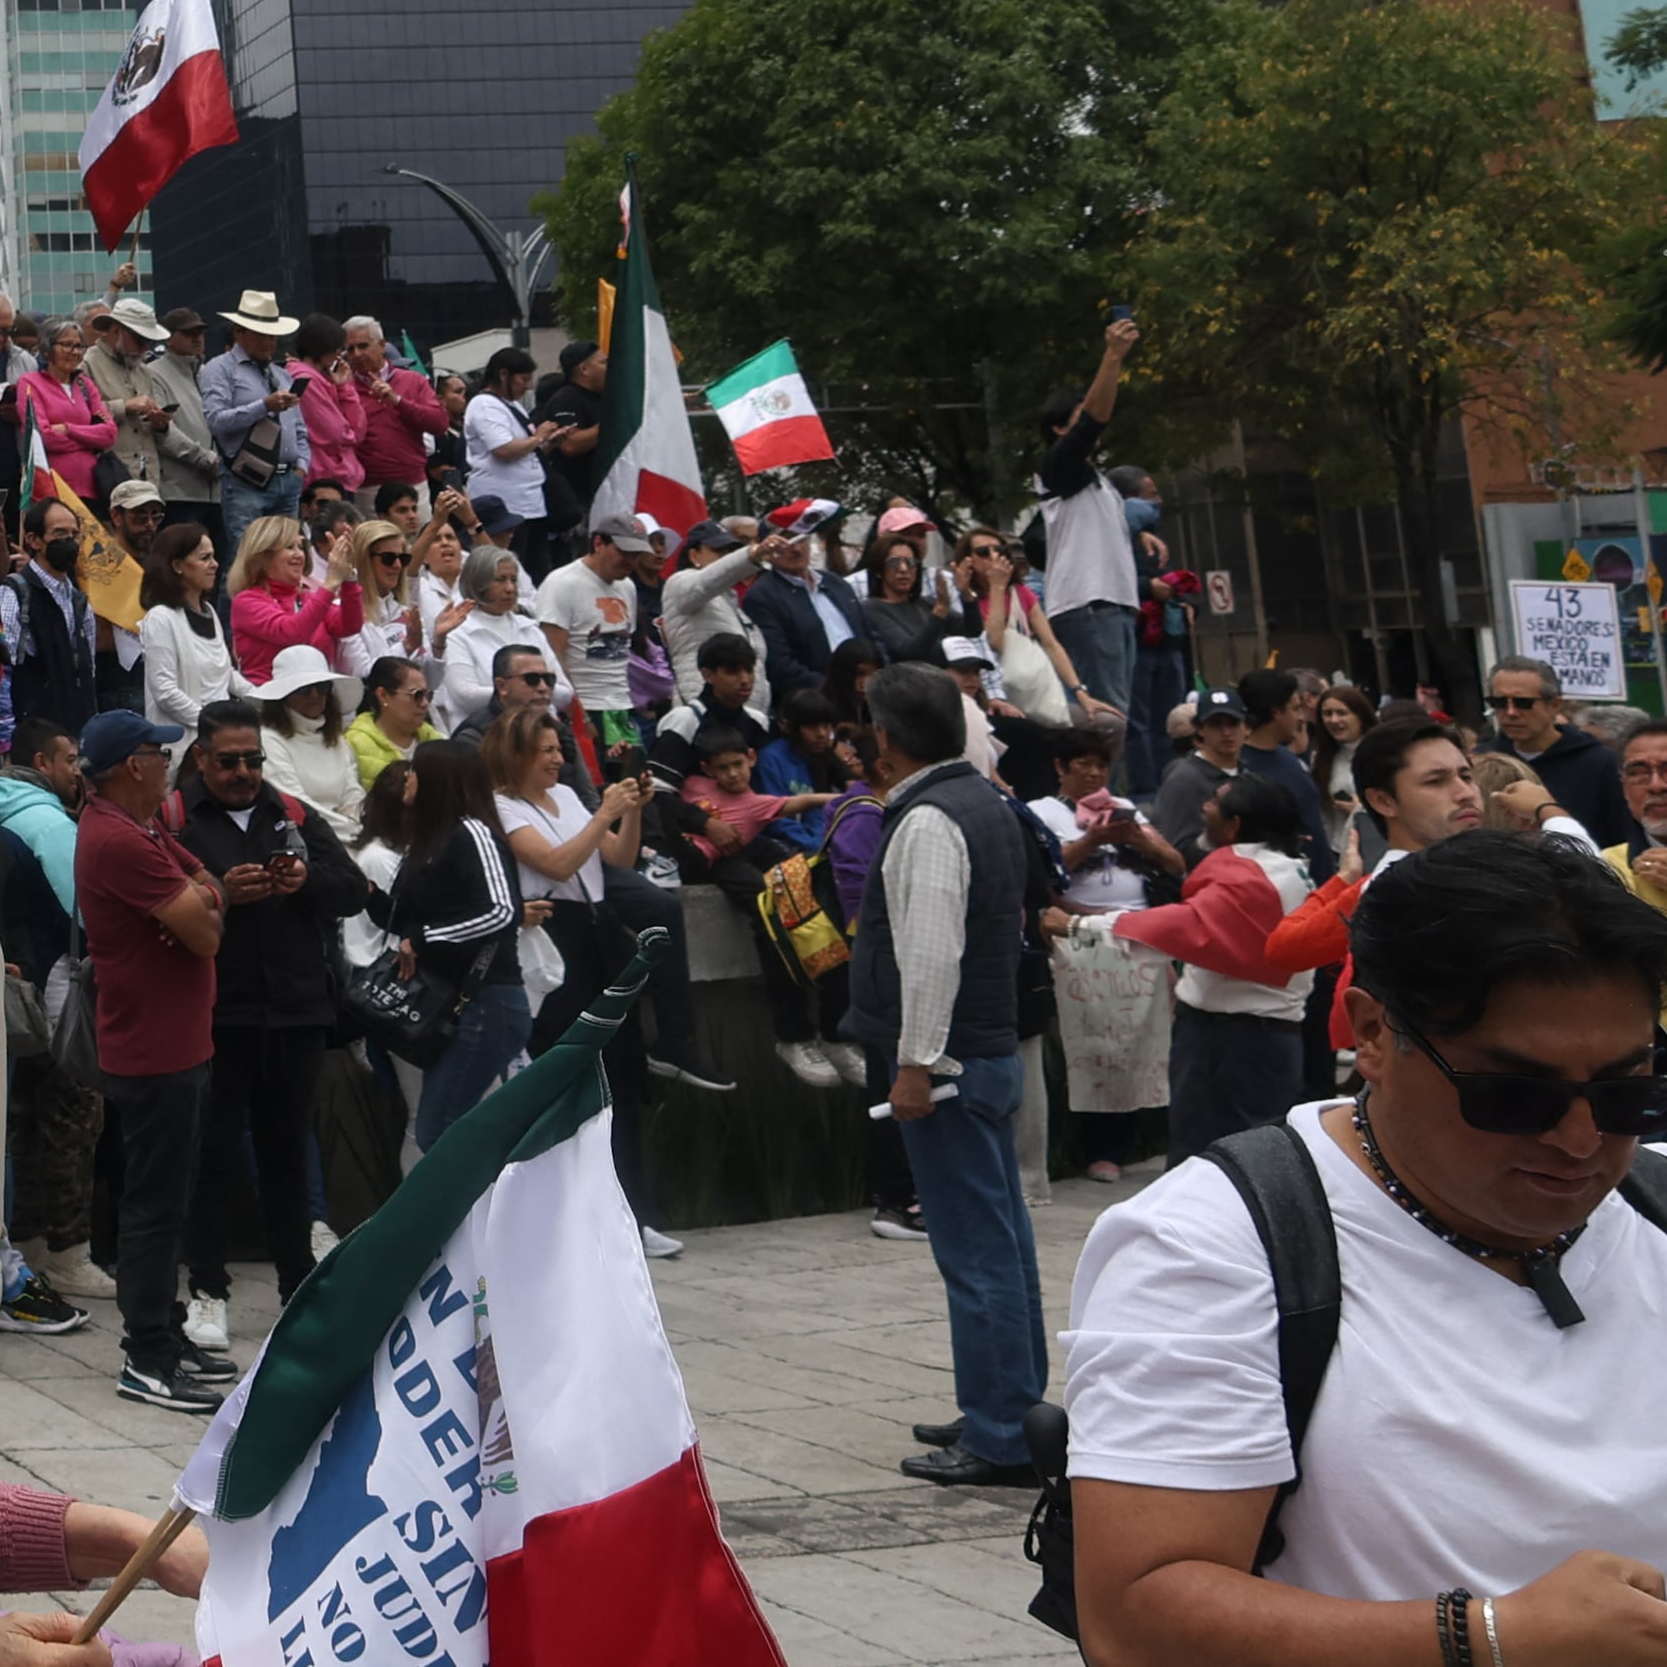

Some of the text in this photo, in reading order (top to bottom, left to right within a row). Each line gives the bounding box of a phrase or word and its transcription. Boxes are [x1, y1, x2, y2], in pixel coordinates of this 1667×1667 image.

[1544, 588, 1582, 618] 43
[1590, 652, 1611, 668] EN
[396, 1000, 422, 1023] AG
[317, 1580, 367, 1664] NO
